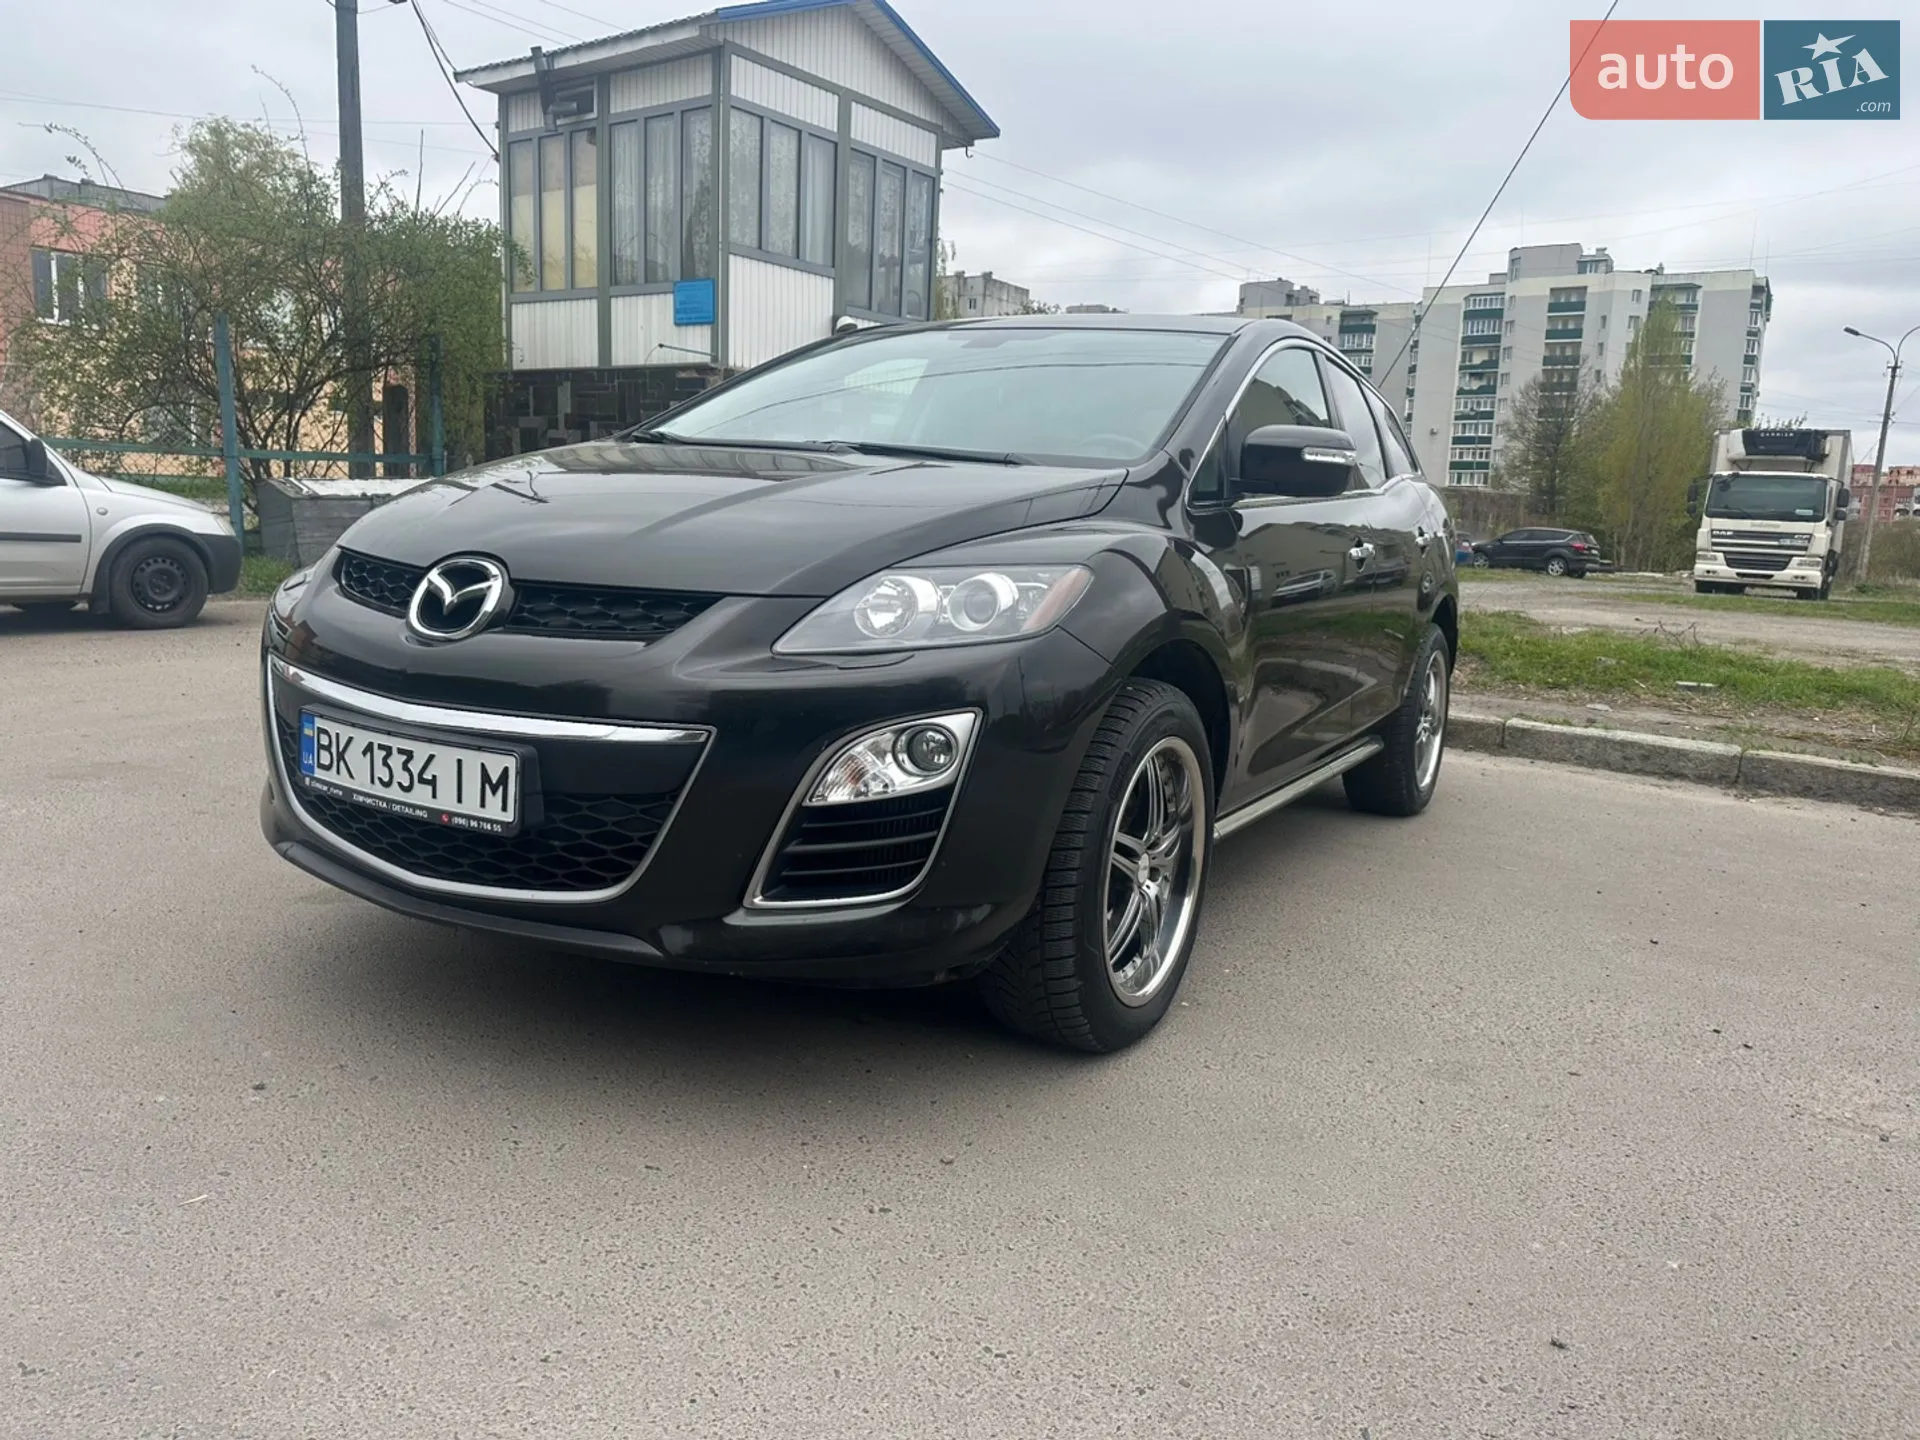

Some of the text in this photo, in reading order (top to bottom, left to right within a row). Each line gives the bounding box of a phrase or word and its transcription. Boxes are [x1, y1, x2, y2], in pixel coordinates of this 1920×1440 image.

[303, 753, 314, 766] UA
[317, 726, 355, 780] BK
[361, 741, 437, 799] 1334
[392, 803, 427, 818] DETAILING
